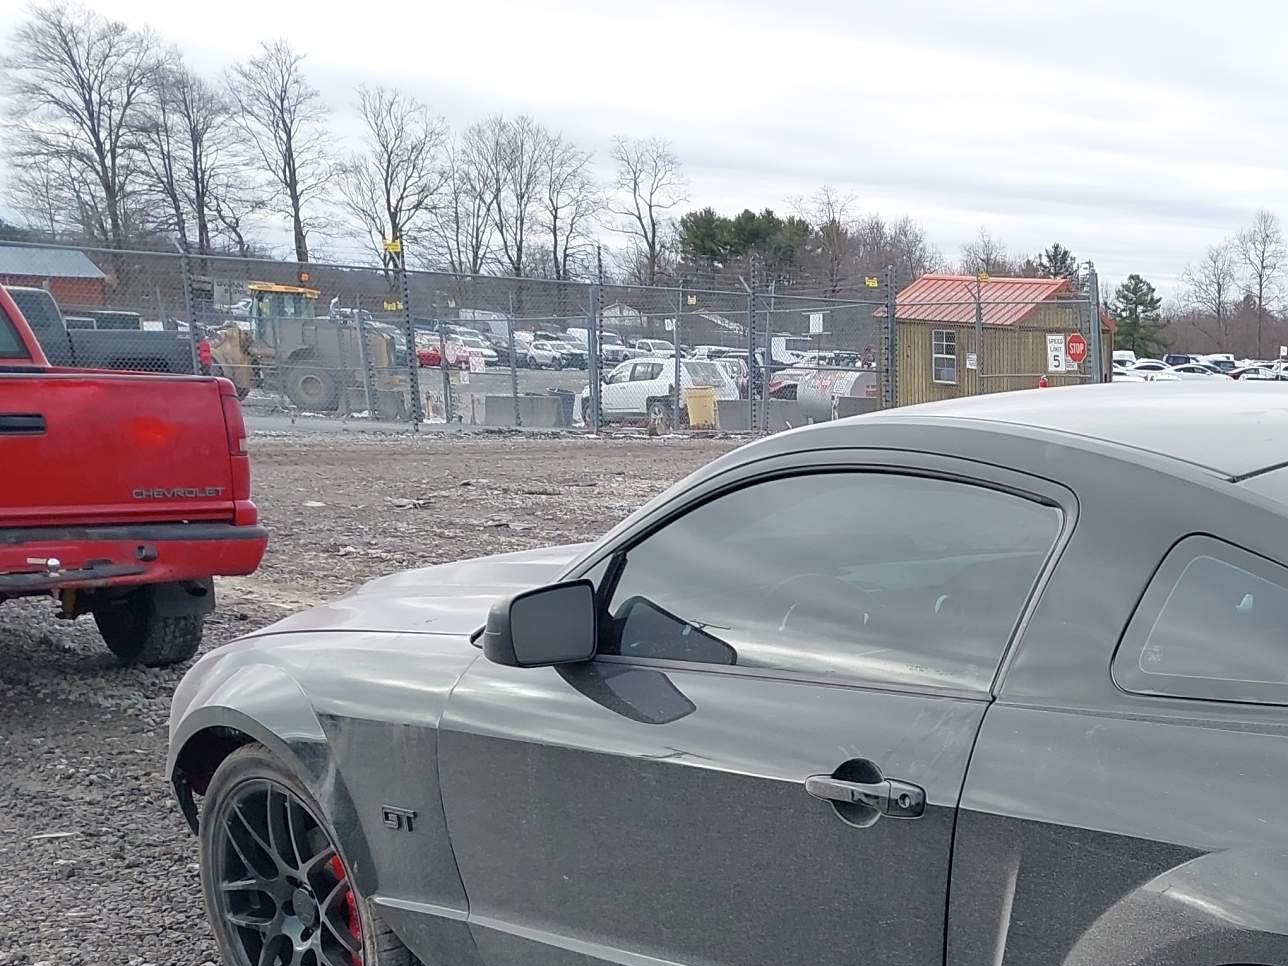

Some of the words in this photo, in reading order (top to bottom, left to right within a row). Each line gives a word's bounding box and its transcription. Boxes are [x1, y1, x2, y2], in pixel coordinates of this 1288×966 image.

[1069, 342, 1084, 354] STOP
[1053, 354, 1061, 368] 5
[132, 486, 226, 499] CHEVROLET
[381, 804, 417, 833] GT
